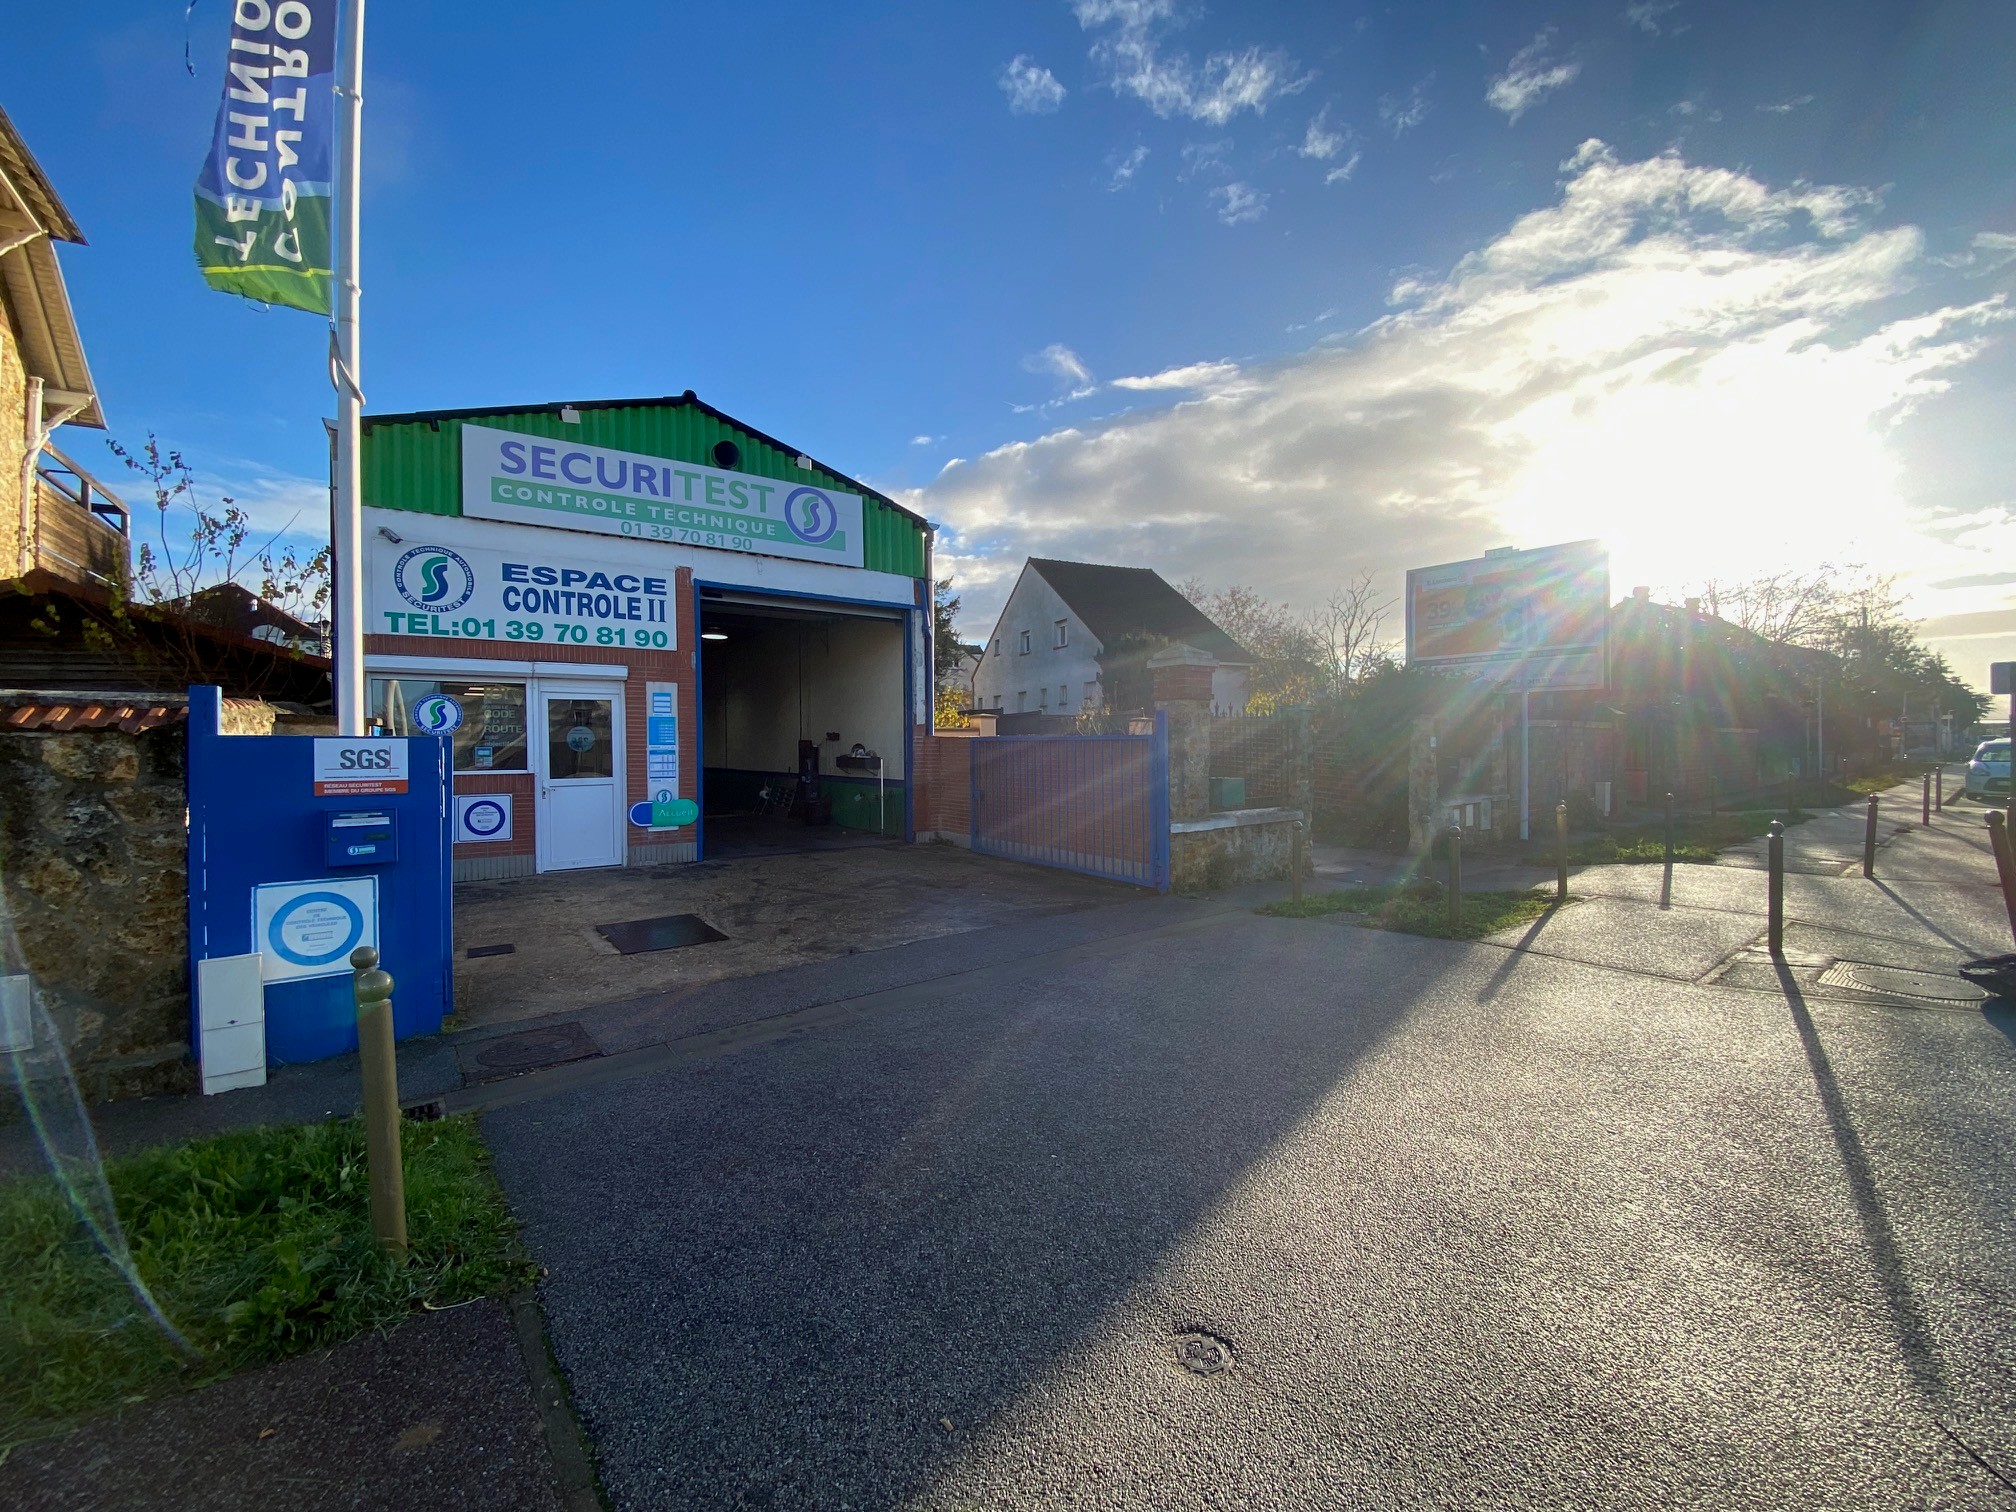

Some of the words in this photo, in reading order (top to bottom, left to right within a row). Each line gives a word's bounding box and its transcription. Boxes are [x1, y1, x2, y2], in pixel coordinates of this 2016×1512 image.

[500, 440, 775, 514] SECURITEST
[498, 484, 637, 516] CONTROLE
[647, 505, 776, 537] TECHNIQUE
[620, 521, 642, 537] 01
[650, 524, 673, 540] 39
[679, 528, 700, 544] 70
[706, 532, 726, 548] 81
[732, 536, 753, 551] 90
[396, 554, 411, 588] CONTROLE
[411, 546, 454, 557] TECHNIQUE
[455, 557, 473, 596] AUTOMOBILE
[502, 562, 667, 596] ESPACE
[402, 591, 466, 613] SECURITEST
[502, 586, 642, 621] CONTROLE
[505, 620, 544, 640] 39
[553, 623, 588, 644] 70
[596, 627, 626, 646] 81
[634, 629, 668, 648] 90
[484, 709, 515, 718] CODE
[484, 725, 522, 733] ROUTE
[340, 749, 390, 769] SGS
[659, 809, 693, 817] Accueil
